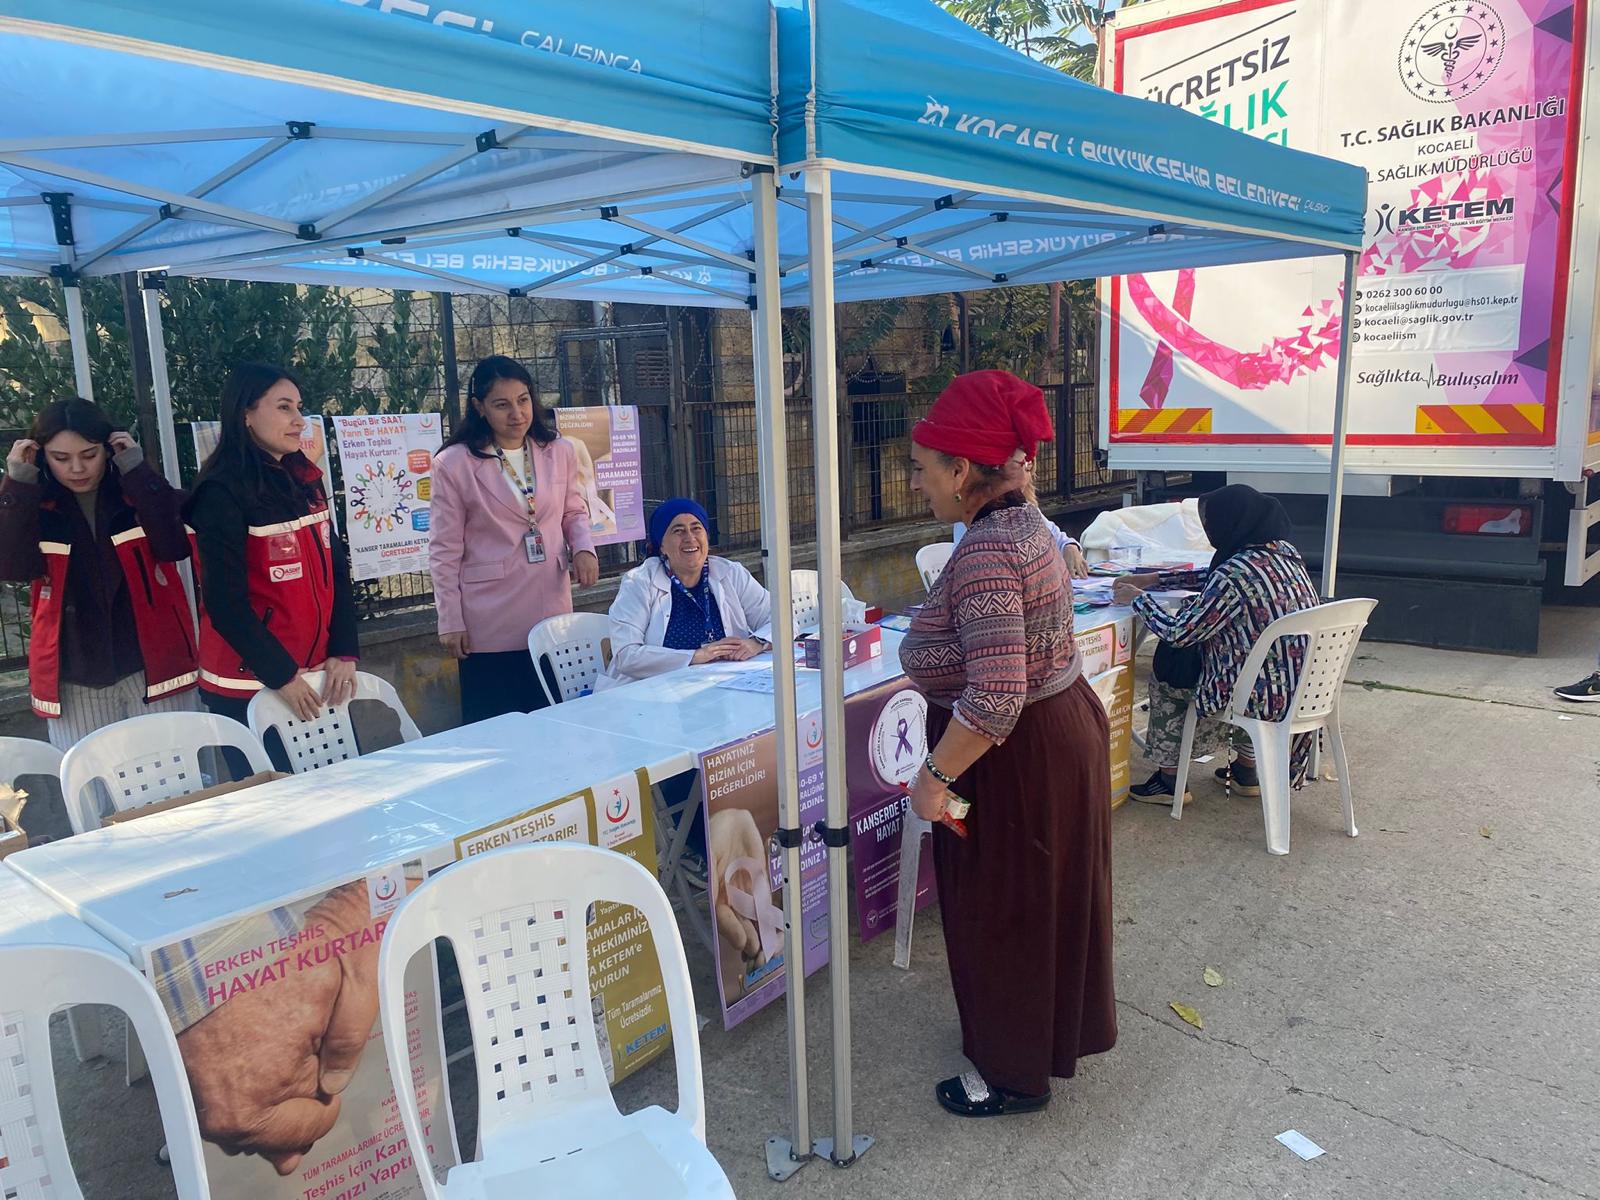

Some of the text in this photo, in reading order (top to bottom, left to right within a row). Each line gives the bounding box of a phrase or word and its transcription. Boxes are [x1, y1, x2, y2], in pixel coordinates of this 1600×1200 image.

[1340, 97, 1565, 148] T.C. SAĞLIK BAKANLIĞI
[1418, 136, 1474, 156] KOCAELİ
[1377, 163, 1427, 182] SAĞLIK
[1430, 147, 1533, 174] MÜDÜRLÜĞÜ
[1399, 197, 1515, 225] KETEM
[1366, 285, 1443, 299] 0262 300 60 00
[1364, 313, 1474, 327] kocaeli@saglik.gov.tr
[1357, 368, 1519, 389] Sağlıkta Buluşalım
[707, 743, 755, 769] HAYATINIZ
[708, 758, 755, 785] BİZİM İÇİN
[710, 768, 766, 801] DEĞERLİDİR!
[856, 801, 900, 836] KANSERDE
[876, 818, 901, 843] HAYAT
[466, 813, 556, 857] ERKEN TEŞHİS
[204, 945, 264, 980] ERKEN
[599, 943, 643, 972] KETEM'e
[207, 957, 290, 1006] HAYAT
[625, 1023, 668, 1055] KETEM
[303, 1167, 320, 1181] TÜM
[321, 1132, 383, 1172] TARAMALARIMIZ
[303, 1174, 345, 1200] Teşhis
[348, 1158, 372, 1179] İçin
